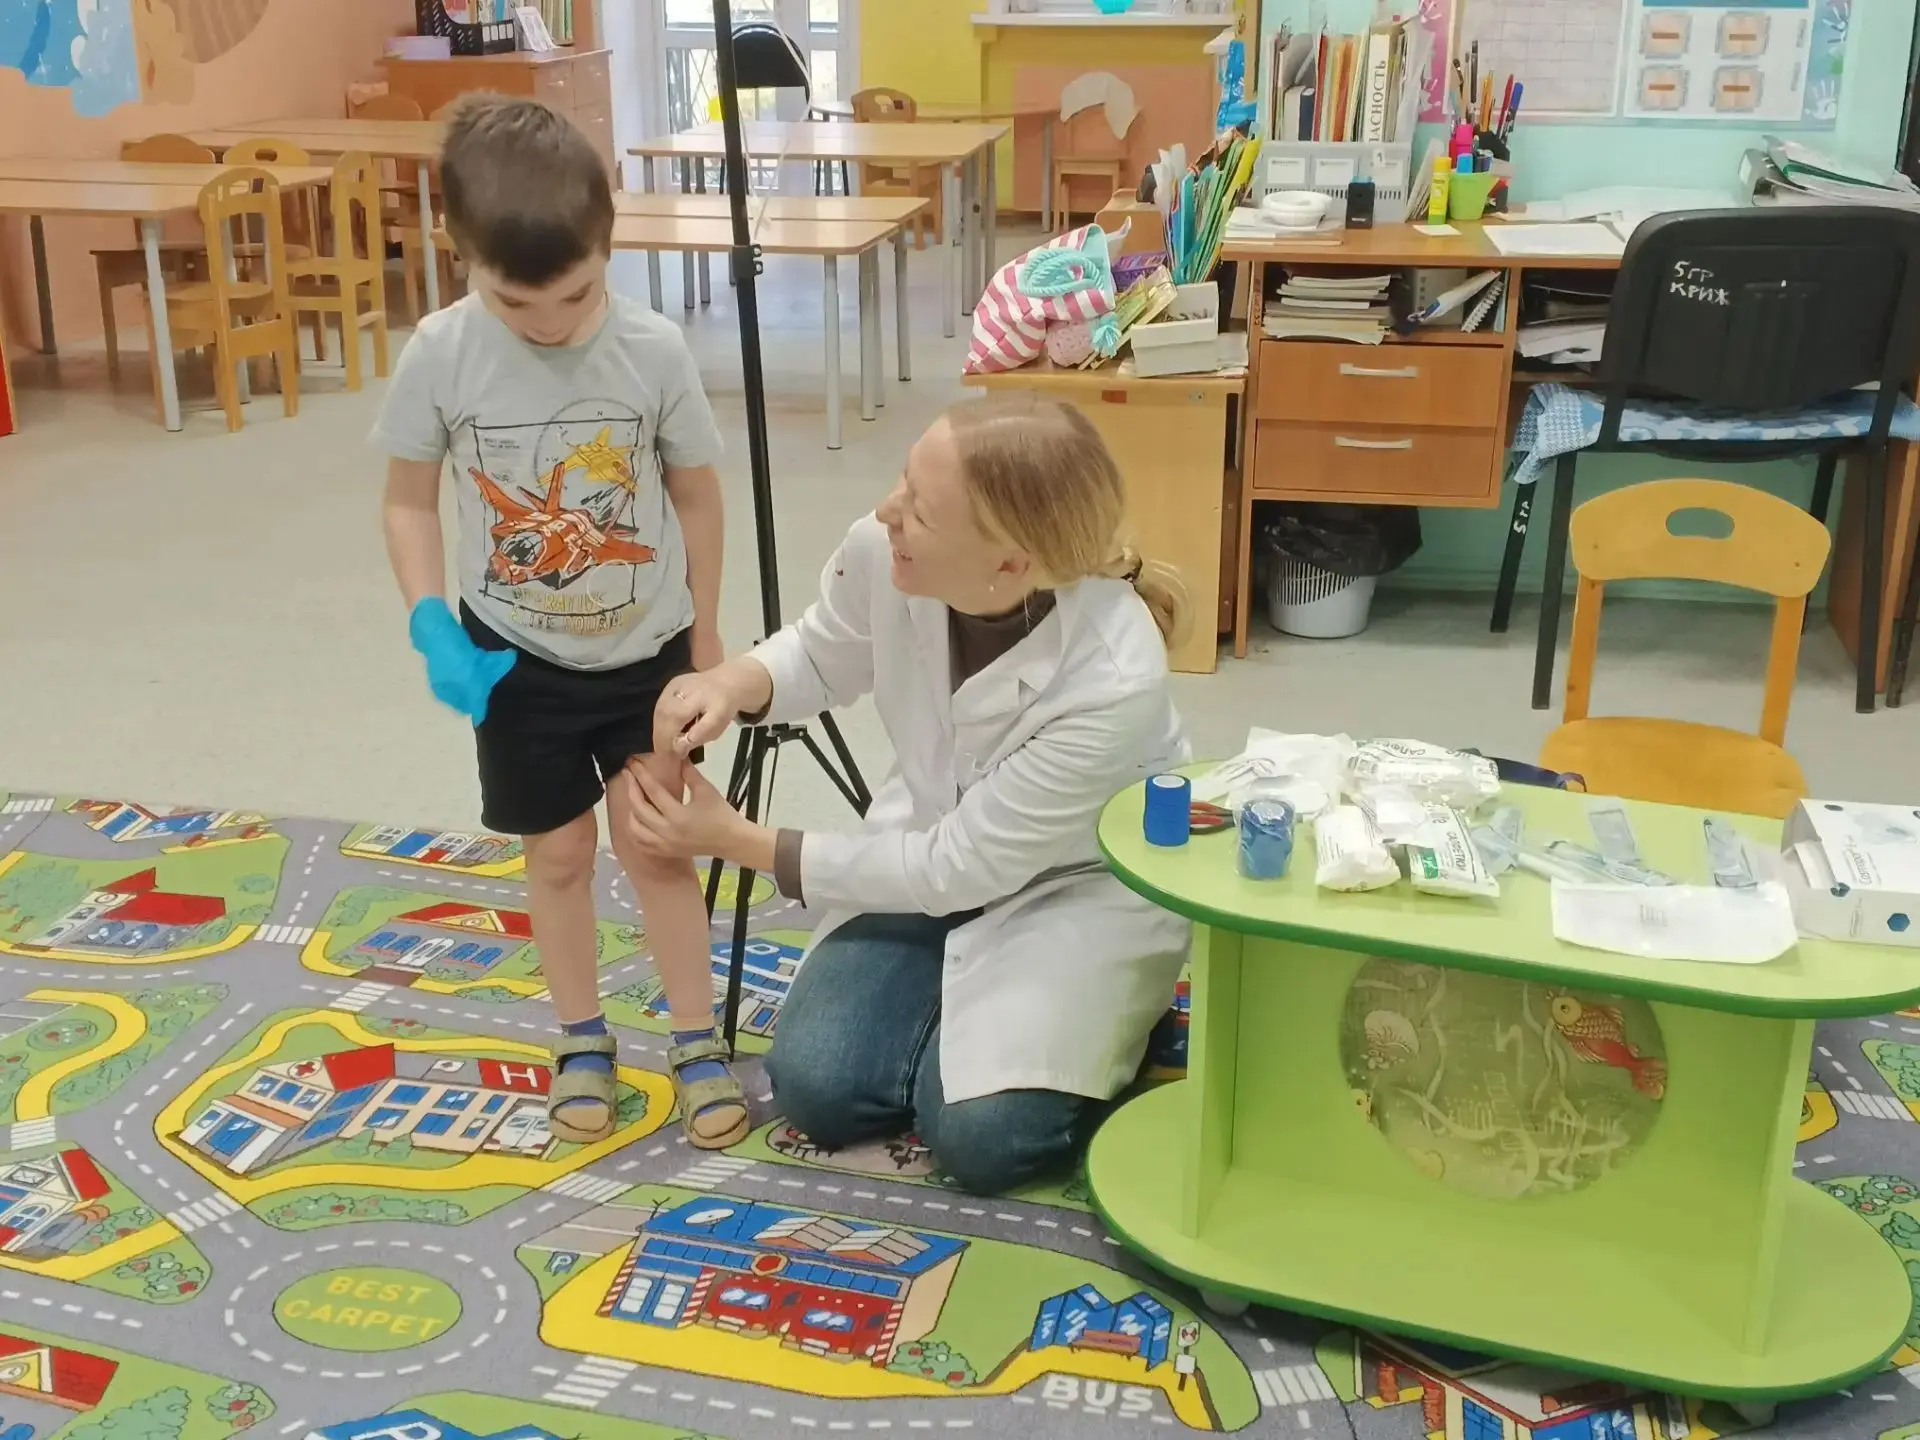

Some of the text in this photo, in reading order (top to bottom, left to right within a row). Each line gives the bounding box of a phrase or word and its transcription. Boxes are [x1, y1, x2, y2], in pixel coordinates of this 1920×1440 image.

[499, 1063, 538, 1088] H
[551, 1255, 573, 1273] P
[327, 1276, 432, 1305] BEST
[283, 1300, 443, 1338] CARPET
[1041, 1374, 1153, 1412] BUS
